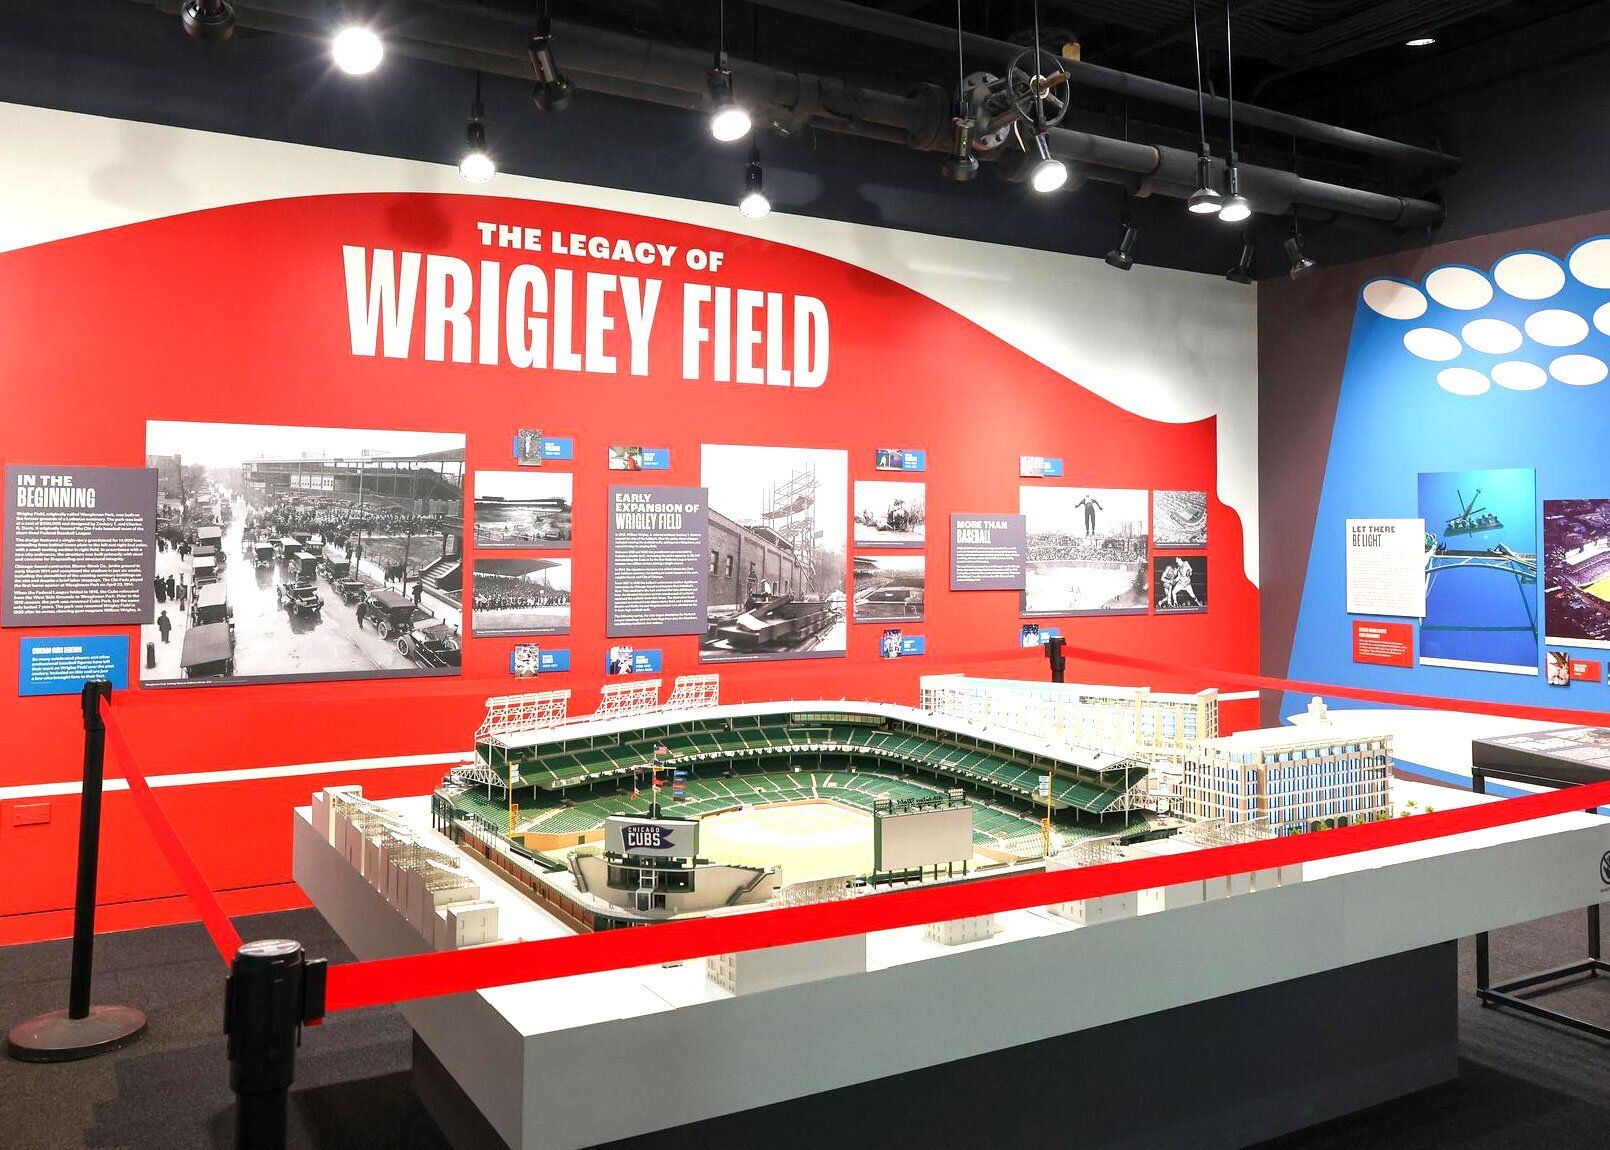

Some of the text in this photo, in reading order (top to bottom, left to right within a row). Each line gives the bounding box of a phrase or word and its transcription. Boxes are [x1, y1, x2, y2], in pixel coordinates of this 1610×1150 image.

[478, 222, 724, 272] THE LEGACY OF
[343, 245, 830, 388] WRIGLEY FIELD
[17, 474, 73, 487] IN THE
[17, 486, 96, 508] BEGINNING
[615, 493, 652, 503] EARLY
[615, 502, 700, 513] EXPANSION OF
[615, 512, 682, 530] WRIGLEY FIELD
[956, 520, 1008, 530] MORE THAN
[1352, 525, 1396, 533] LET THERE
[1352, 533, 1382, 548] BE LIGHT
[628, 832, 661, 847] CUBS
